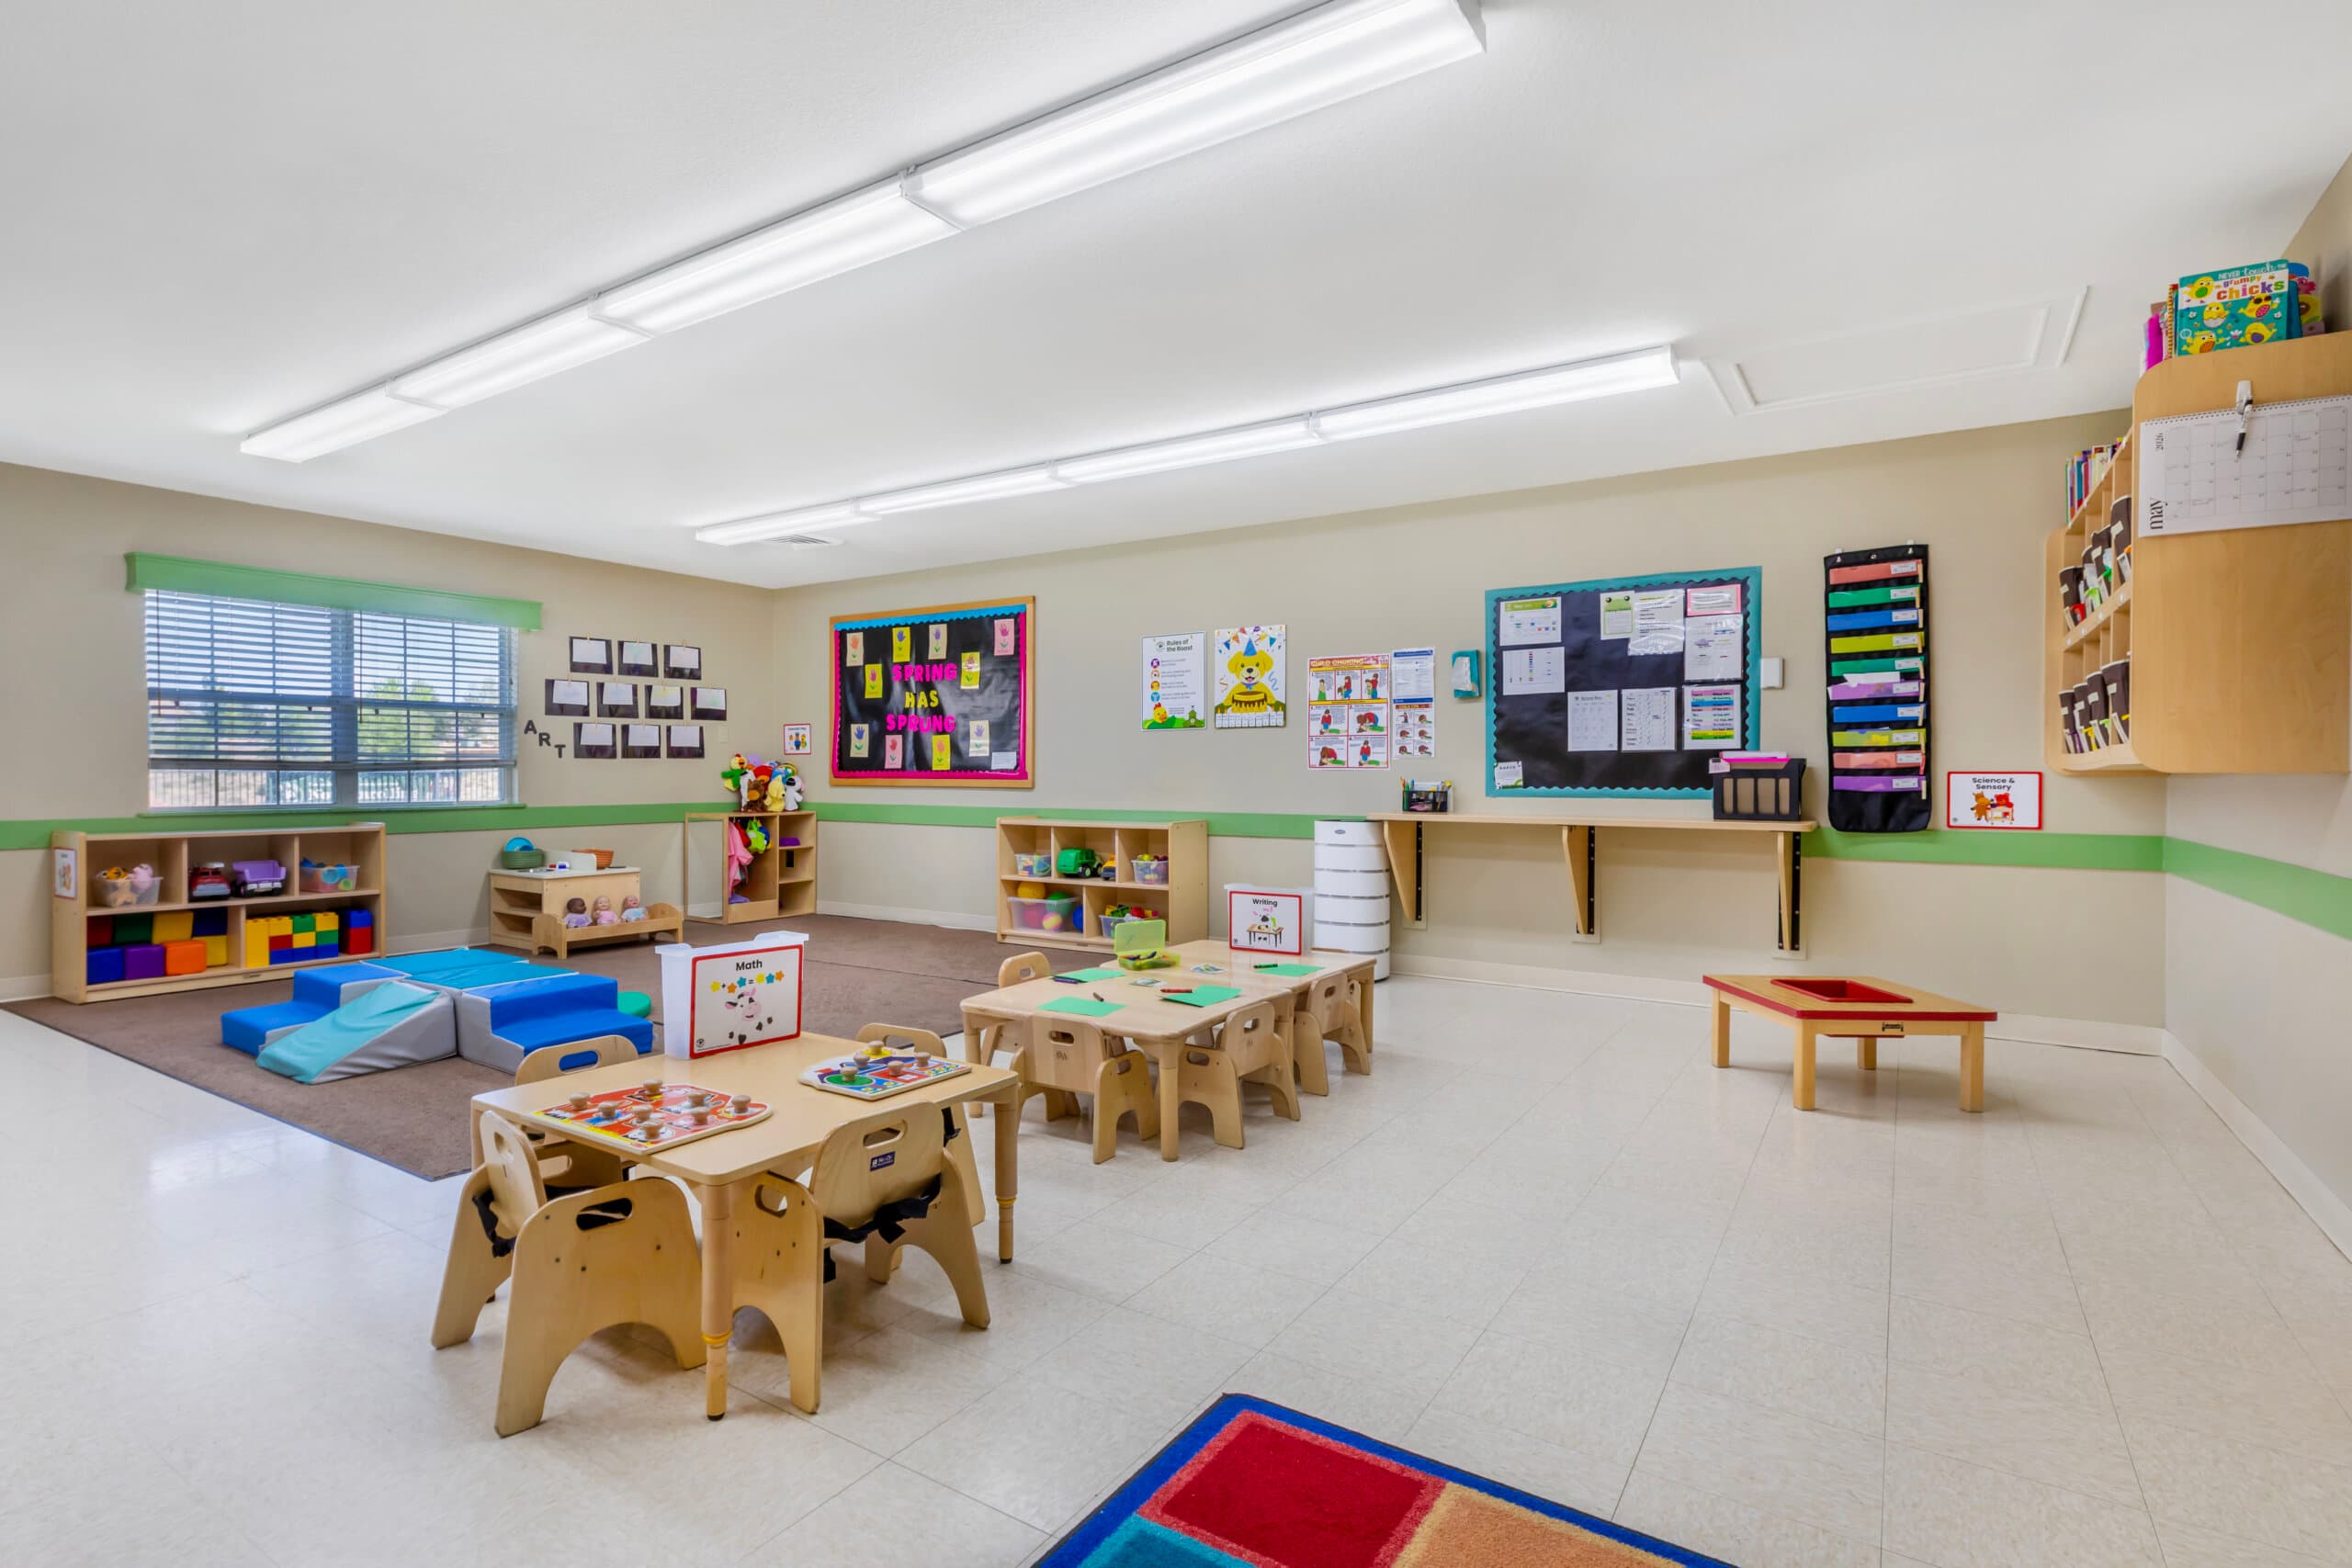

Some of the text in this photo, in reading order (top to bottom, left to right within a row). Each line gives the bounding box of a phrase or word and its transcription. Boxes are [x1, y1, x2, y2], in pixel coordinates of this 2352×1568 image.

[2219, 270, 2241, 280] NEVER
[2223, 275, 2262, 288] grumpy
[2216, 281, 2285, 300] chicks
[2150, 497, 2168, 530] may
[891, 662, 957, 682] SPRING
[904, 690, 940, 708] HAS
[885, 714, 956, 733] SPRUNG
[1252, 898, 1278, 908] Writing
[736, 959, 763, 971] Math
